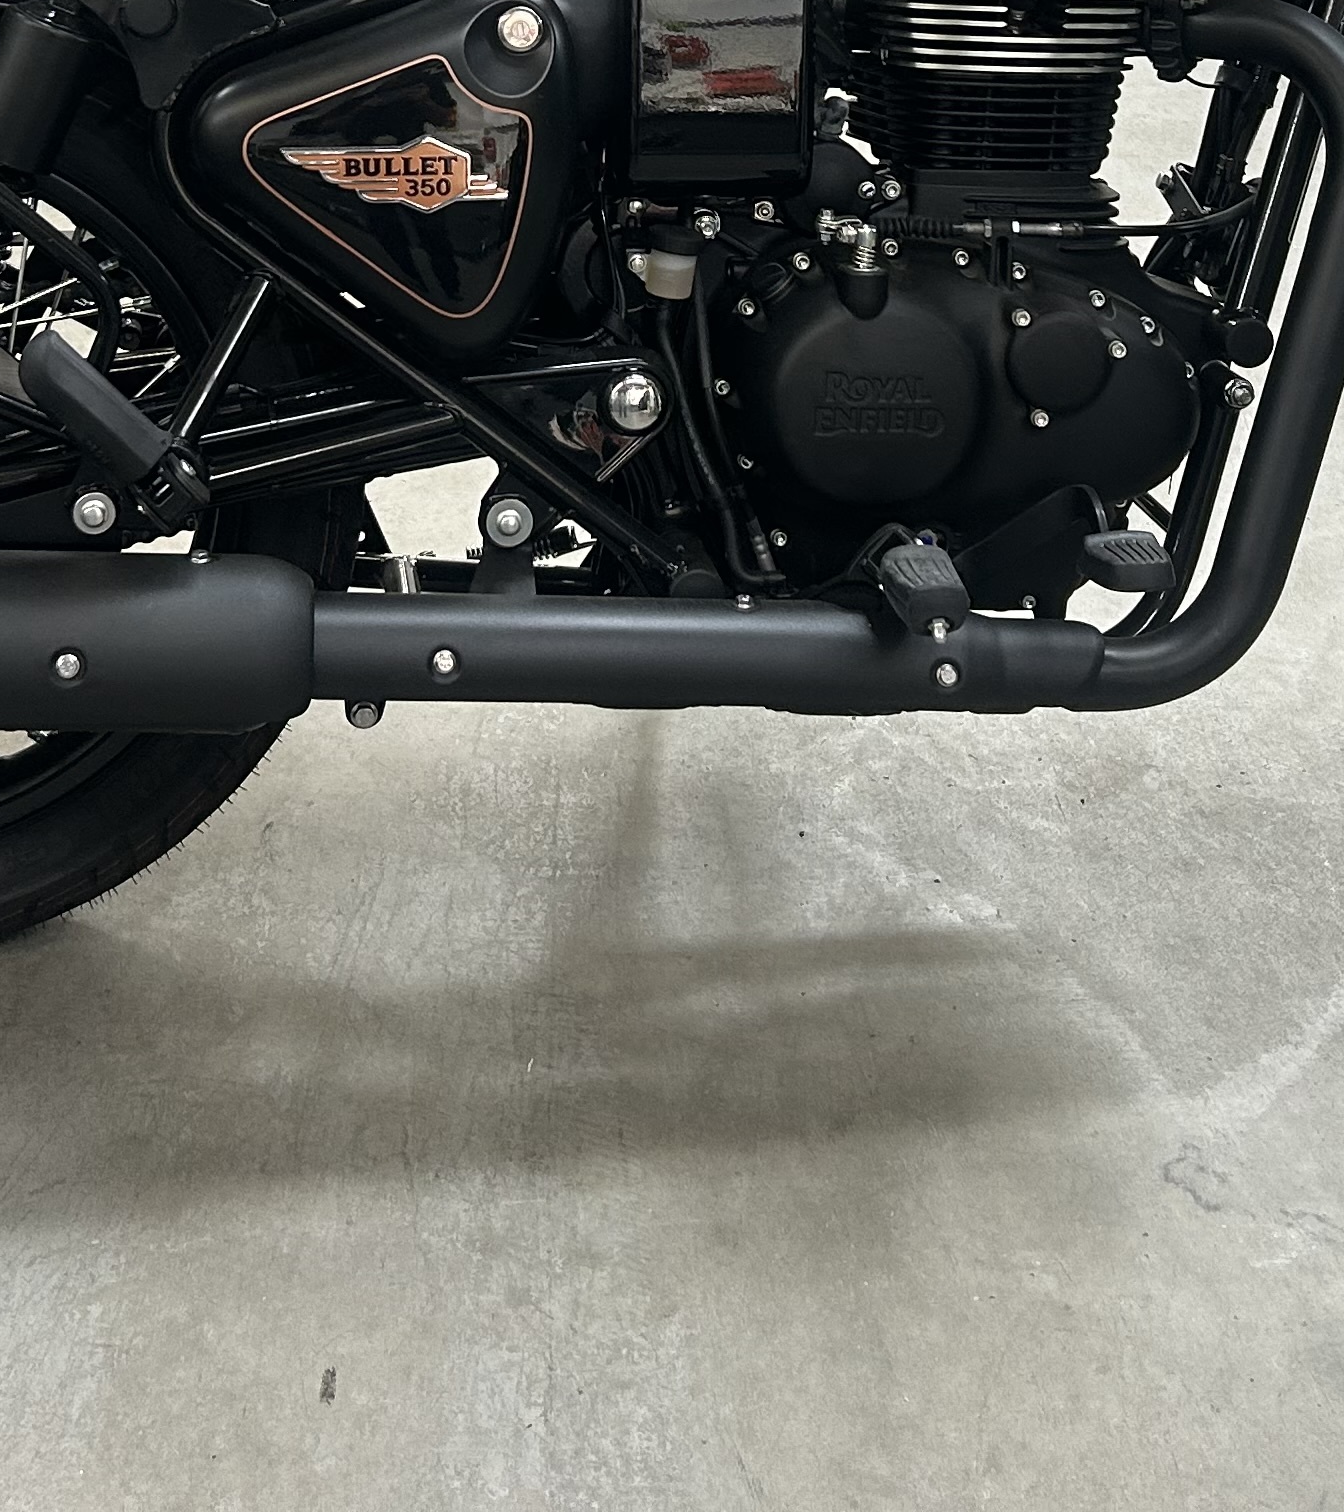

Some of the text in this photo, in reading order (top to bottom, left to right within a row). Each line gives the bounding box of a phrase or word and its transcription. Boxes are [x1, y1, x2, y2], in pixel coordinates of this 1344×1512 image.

[342, 156, 458, 177] BULLET
[404, 177, 452, 197] 350
[825, 370, 933, 406] ROYAL
[813, 405, 948, 438] ENFIELD
